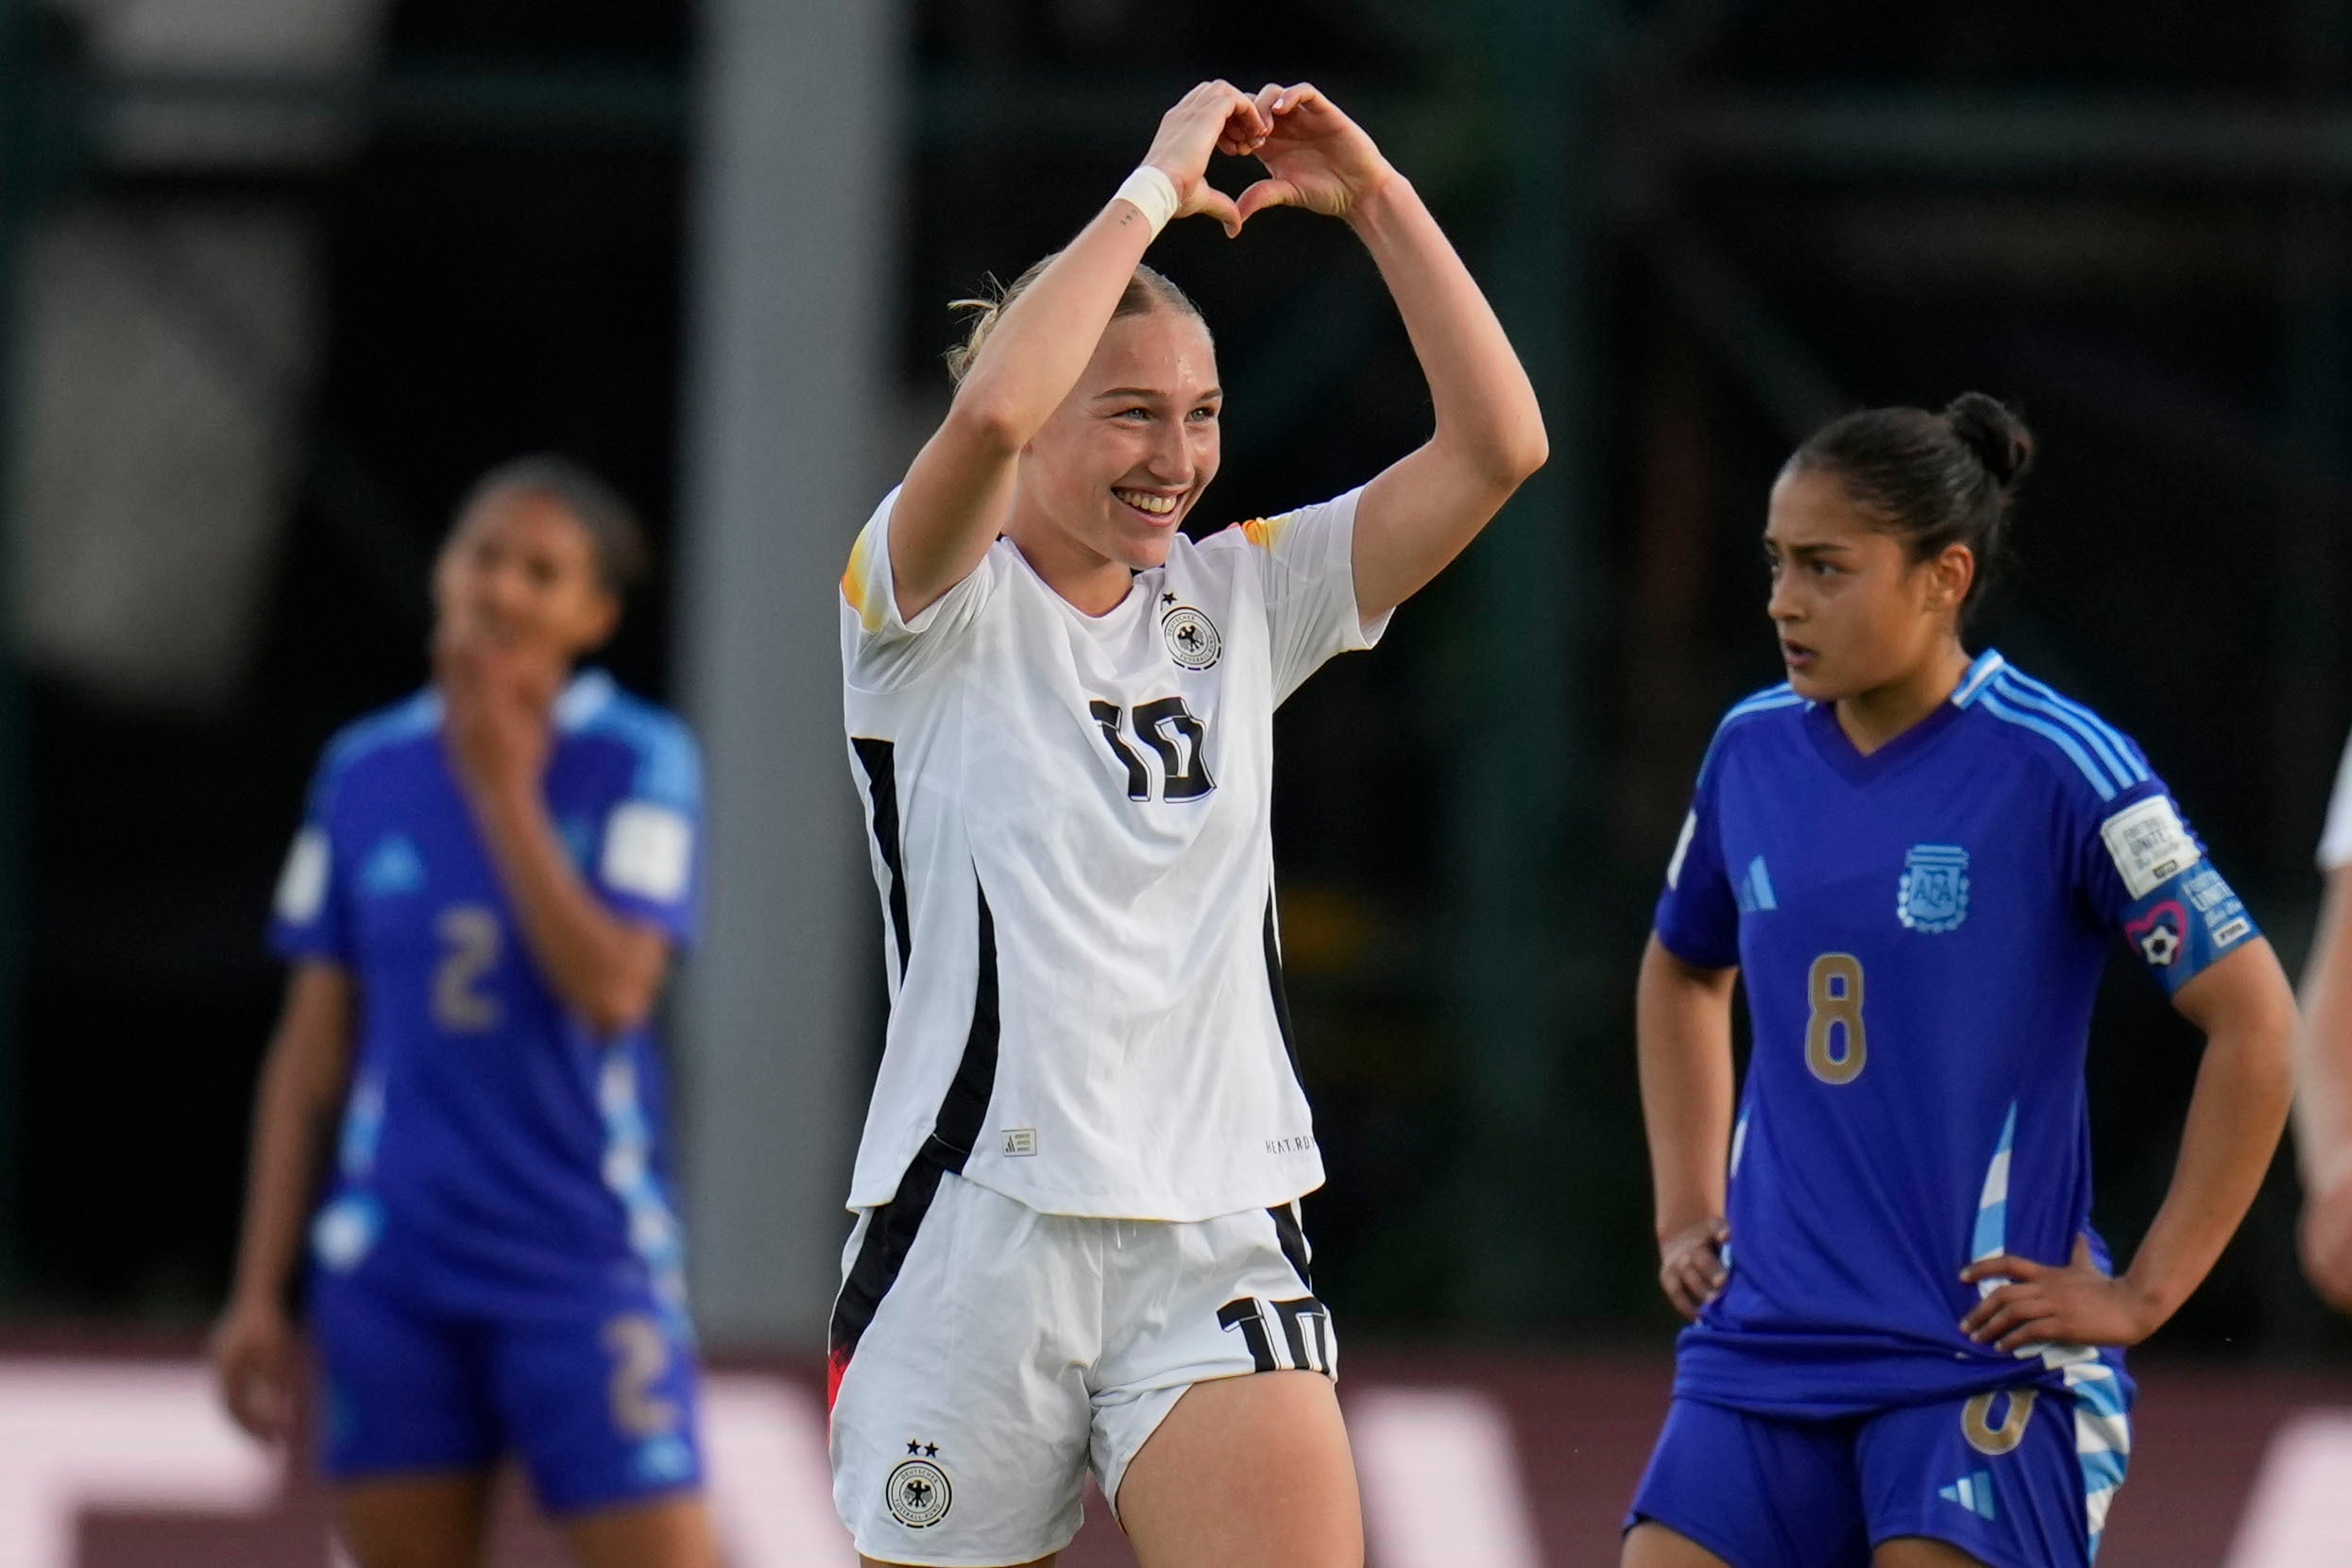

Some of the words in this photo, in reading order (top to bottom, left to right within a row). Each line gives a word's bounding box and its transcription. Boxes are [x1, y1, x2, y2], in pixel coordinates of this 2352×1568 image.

[1089, 696, 1217, 803] 10
[435, 902, 505, 1031] 2
[1805, 951, 1866, 1085] 8
[599, 1311, 678, 1438] 2
[1216, 1296, 1330, 1374] 10
